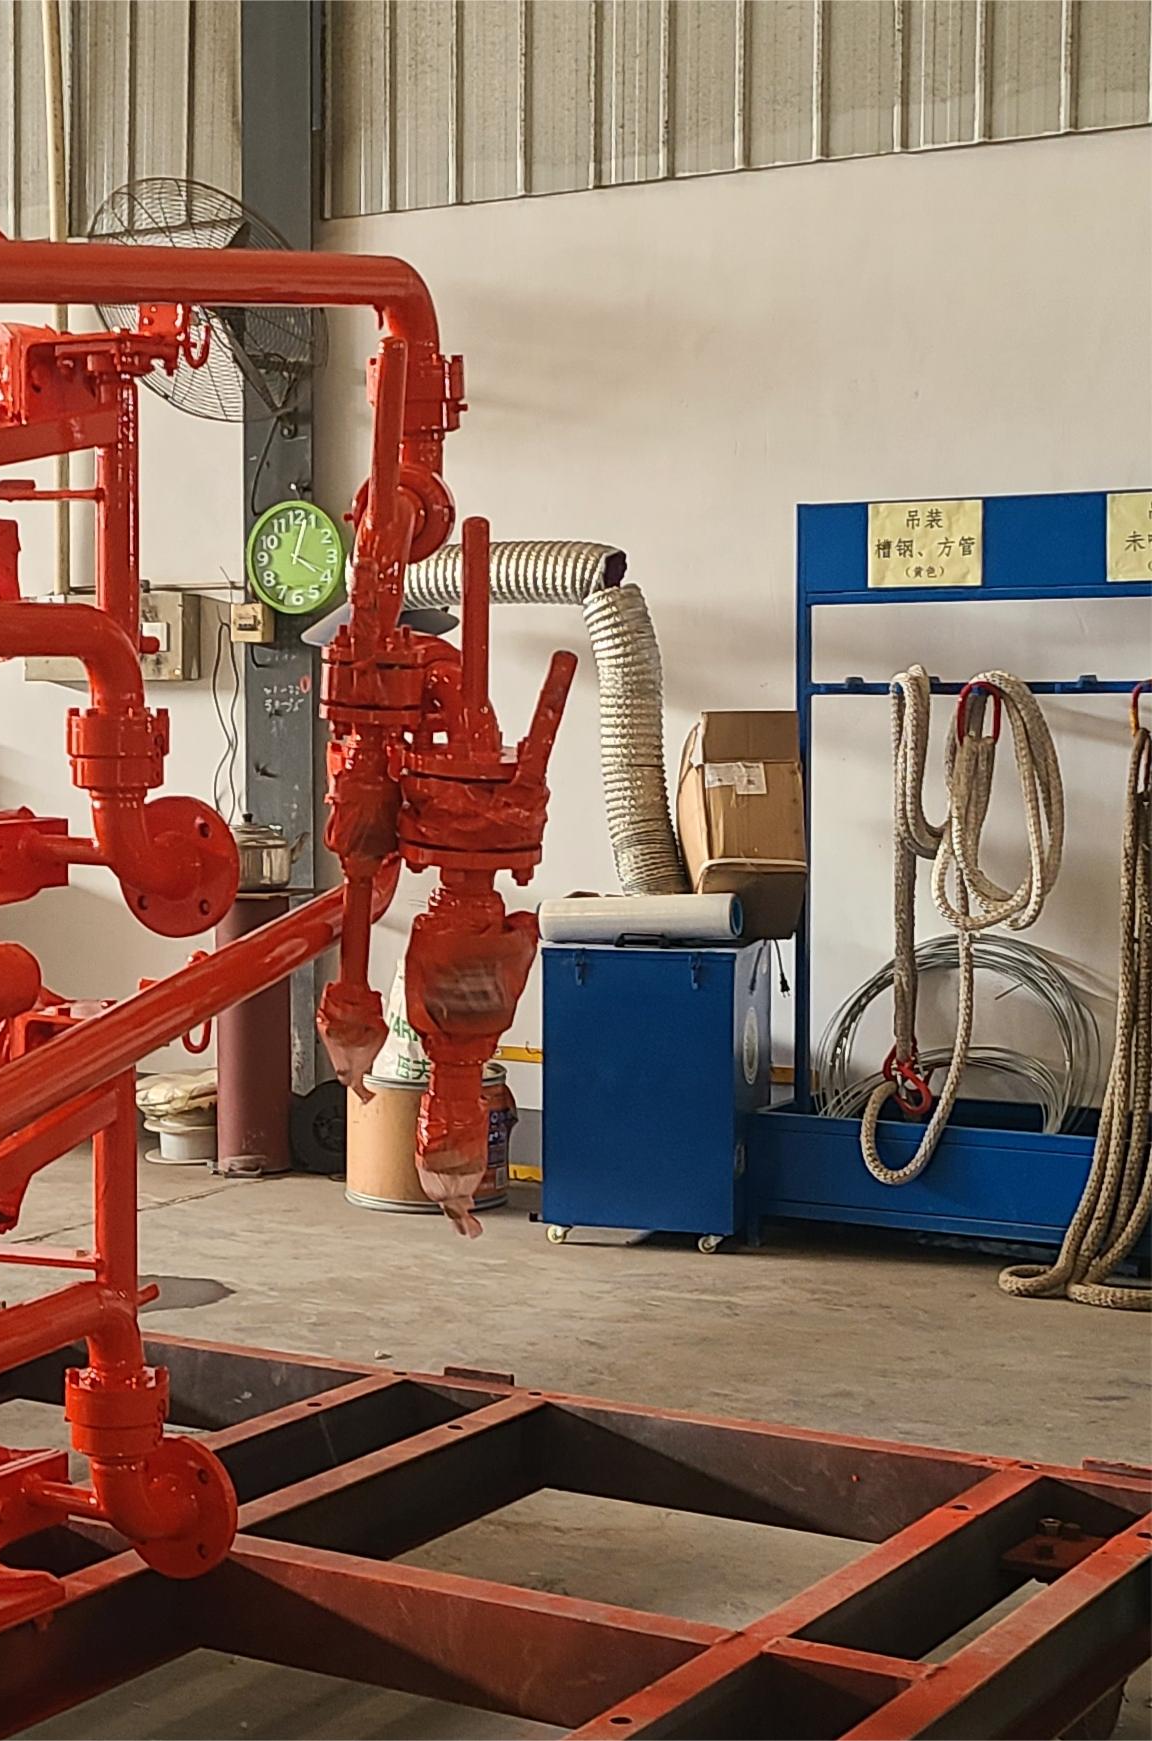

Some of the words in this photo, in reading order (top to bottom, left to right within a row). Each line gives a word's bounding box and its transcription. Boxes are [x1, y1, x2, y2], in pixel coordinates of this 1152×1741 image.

[272, 518, 286, 533] 11
[288, 510, 306, 526] 12
[308, 514, 316, 529] 1
[906, 508, 944, 530] 吊装
[261, 535, 278, 550] 10
[321, 529, 332, 544] 2
[875, 536, 976, 559] 槽钢、方管
[257, 551, 269, 567] 9
[326, 549, 337, 564] 3
[263, 571, 276, 587] 8
[320, 569, 332, 584] 4
[276, 585, 288, 600] 7
[292, 589, 304, 605] 6
[308, 585, 320, 599] 5
